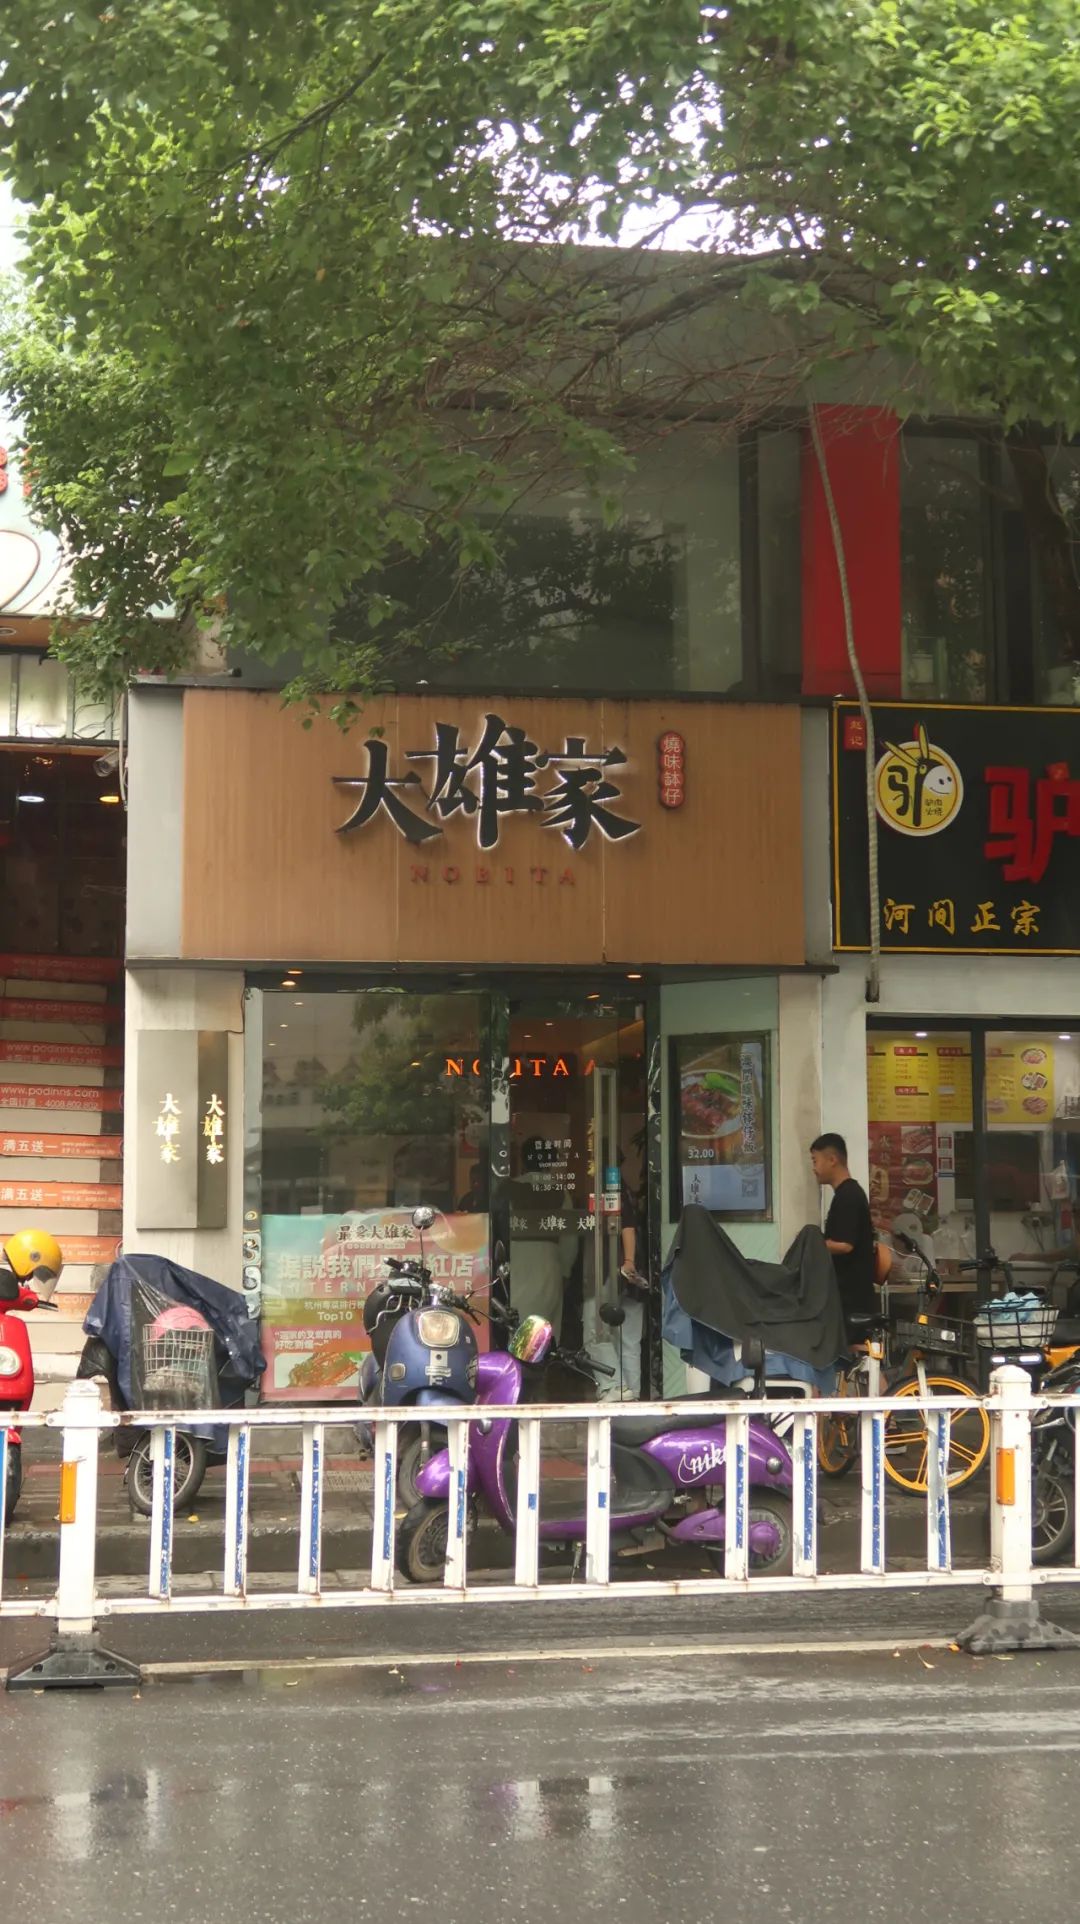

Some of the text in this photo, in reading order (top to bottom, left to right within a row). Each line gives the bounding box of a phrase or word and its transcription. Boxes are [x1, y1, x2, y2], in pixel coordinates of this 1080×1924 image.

[331, 713, 641, 850] 大雄家
[984, 762, 1080, 884] 驴
[410, 864, 576, 886] NOBITA
[1, 1086, 99, 1098] www.podinns.com
[152, 1093, 182, 1164] 大雄家
[200, 1094, 225, 1165] 大雄家
[3, 1139, 58, 1153] 满五送一
[687, 1149, 714, 1159] 32.00
[1, 1188, 58, 1202] 满五送一
[318, 1311, 353, 1322] Top10
